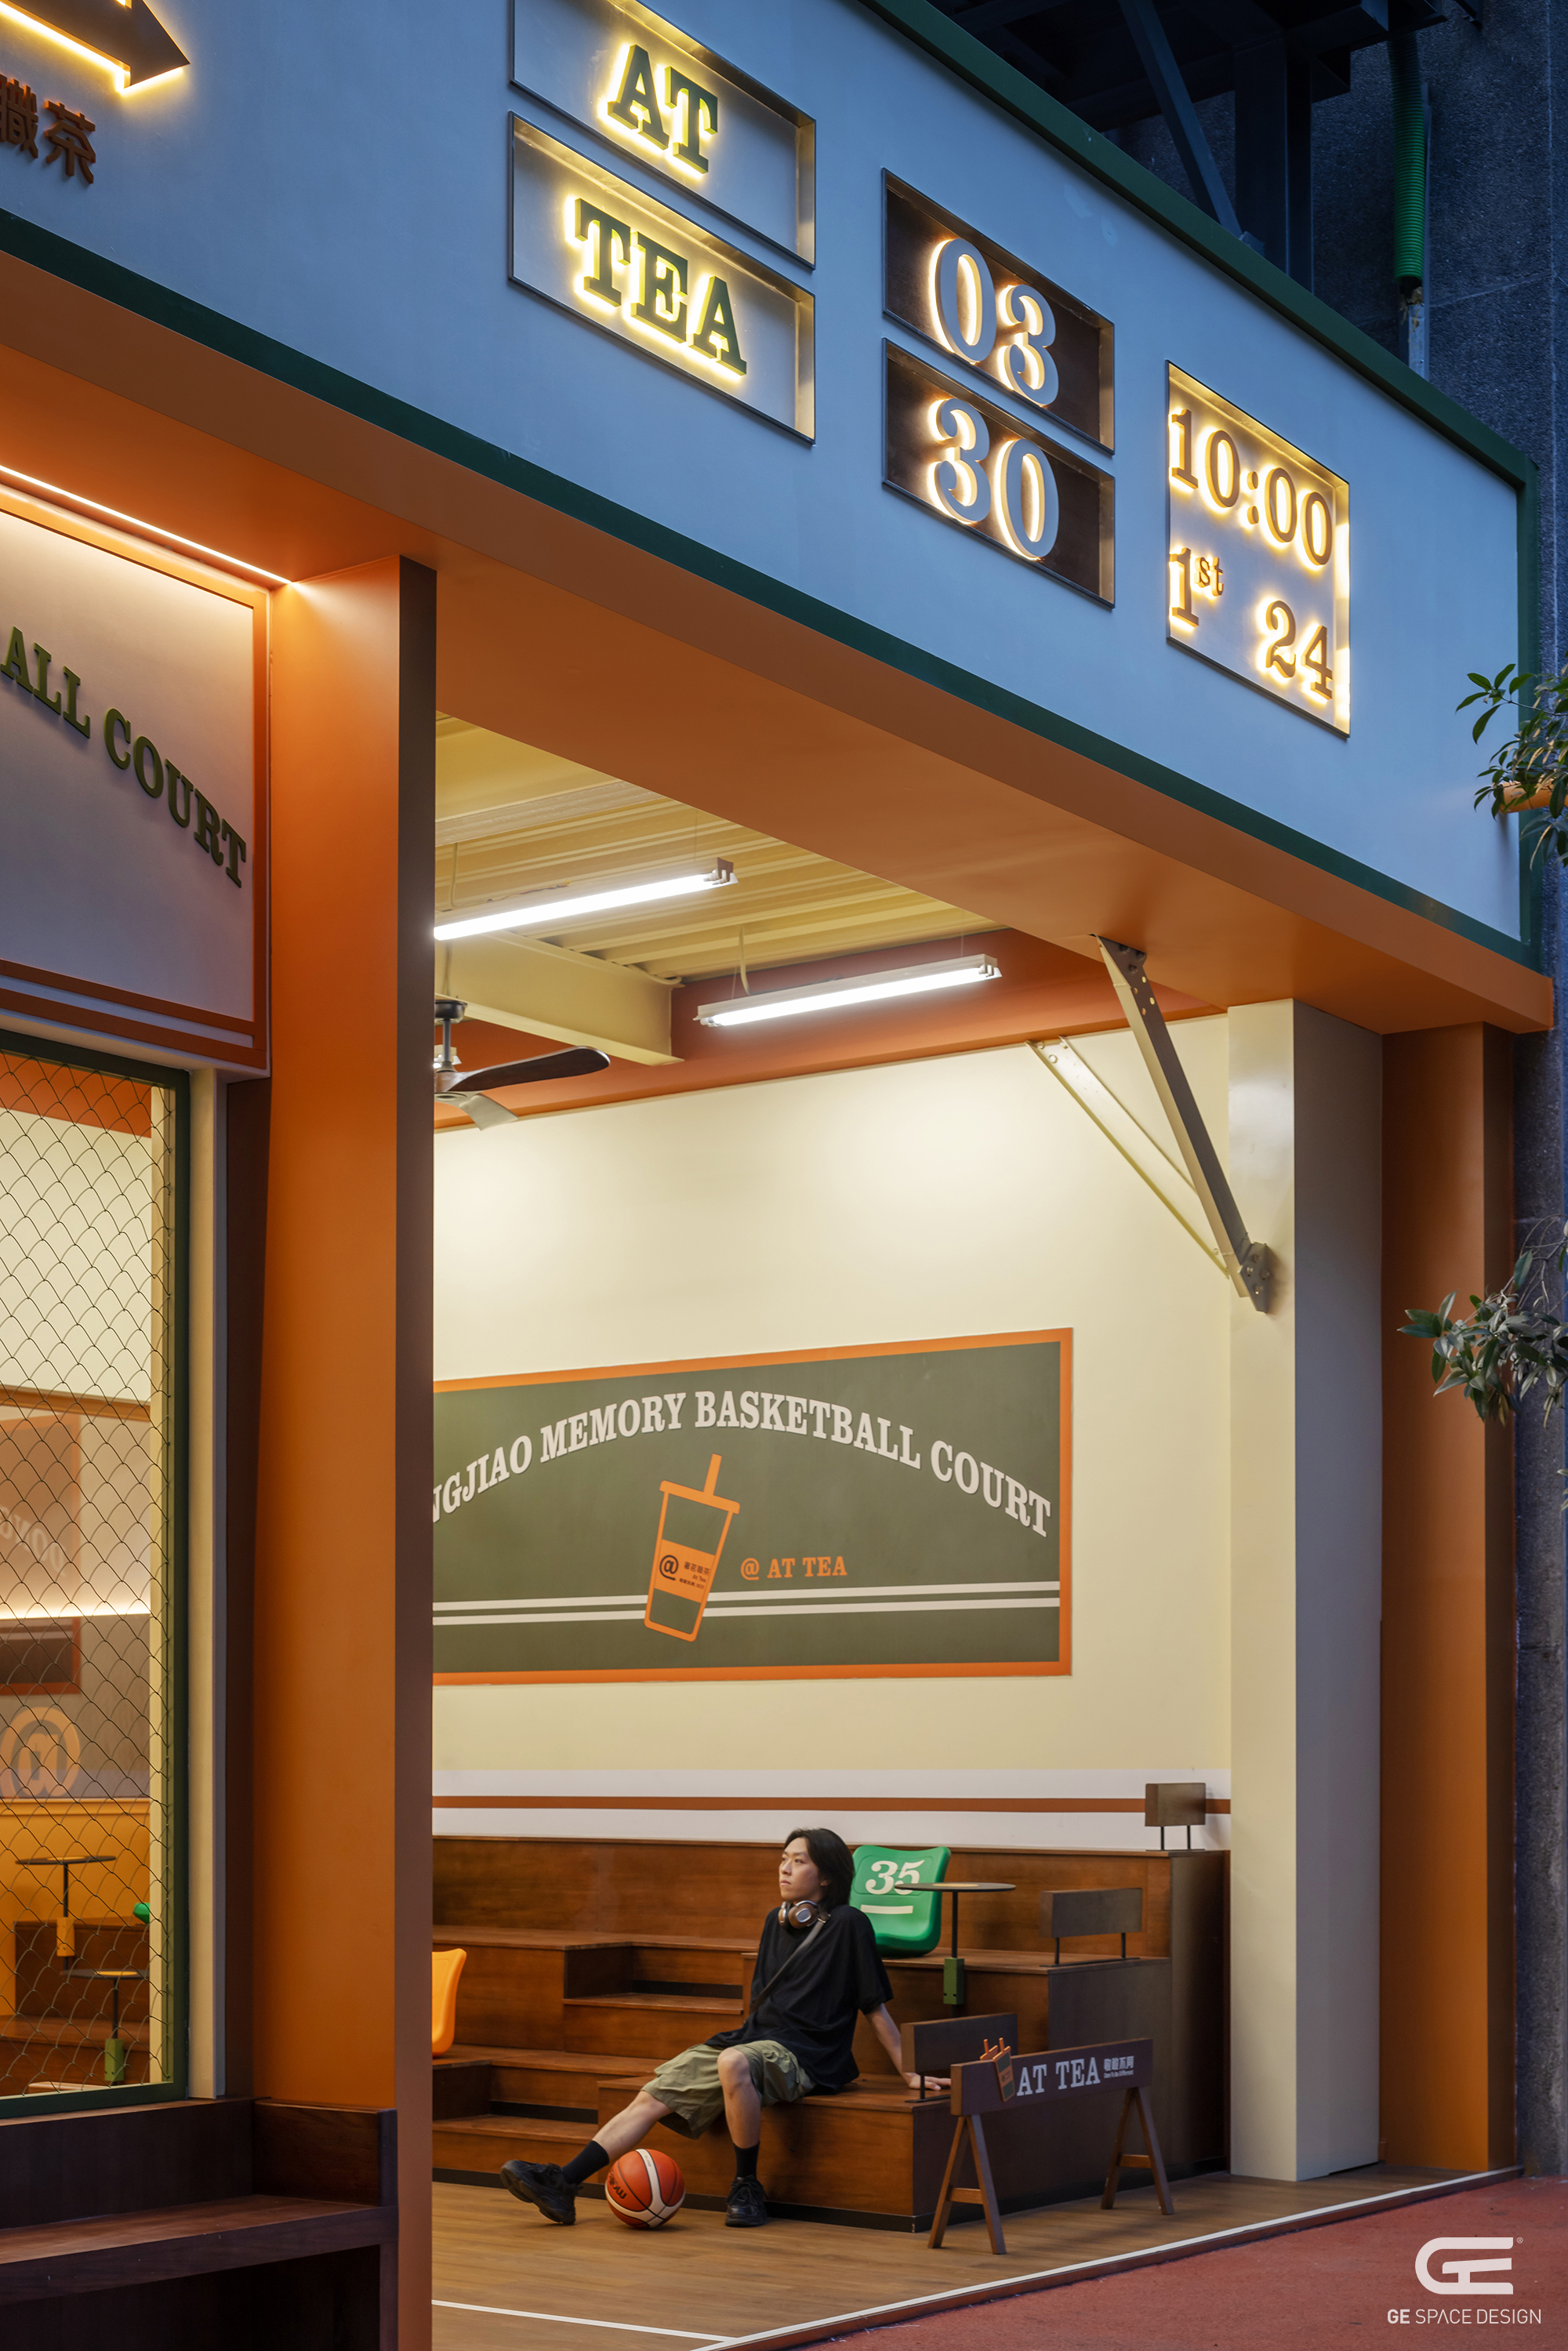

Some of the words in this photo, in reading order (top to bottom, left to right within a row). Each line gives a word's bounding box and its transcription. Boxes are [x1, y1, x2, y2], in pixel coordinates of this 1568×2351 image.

[607, 44, 718, 175] AT
[574, 198, 747, 376] TEA
[931, 238, 1059, 406] 03
[931, 397, 1059, 560] 30
[1171, 408, 1332, 566] 10:00
[1171, 547, 1225, 626] 1st
[1265, 600, 1333, 699] 24
[0, 626, 91, 739] ALL
[103, 707, 247, 888] COURT
[540, 1392, 687, 1464] MEMORY
[695, 1390, 921, 1470] BASKETBALL
[931, 1439, 1051, 1537] COURT
[740, 1557, 760, 1580] @
[767, 1558, 796, 1579] AT
[802, 1555, 848, 1578] TEA
[865, 1859, 925, 1896] 35
[1016, 2063, 1047, 2097] AT
[1055, 2056, 1102, 2091] TEA
